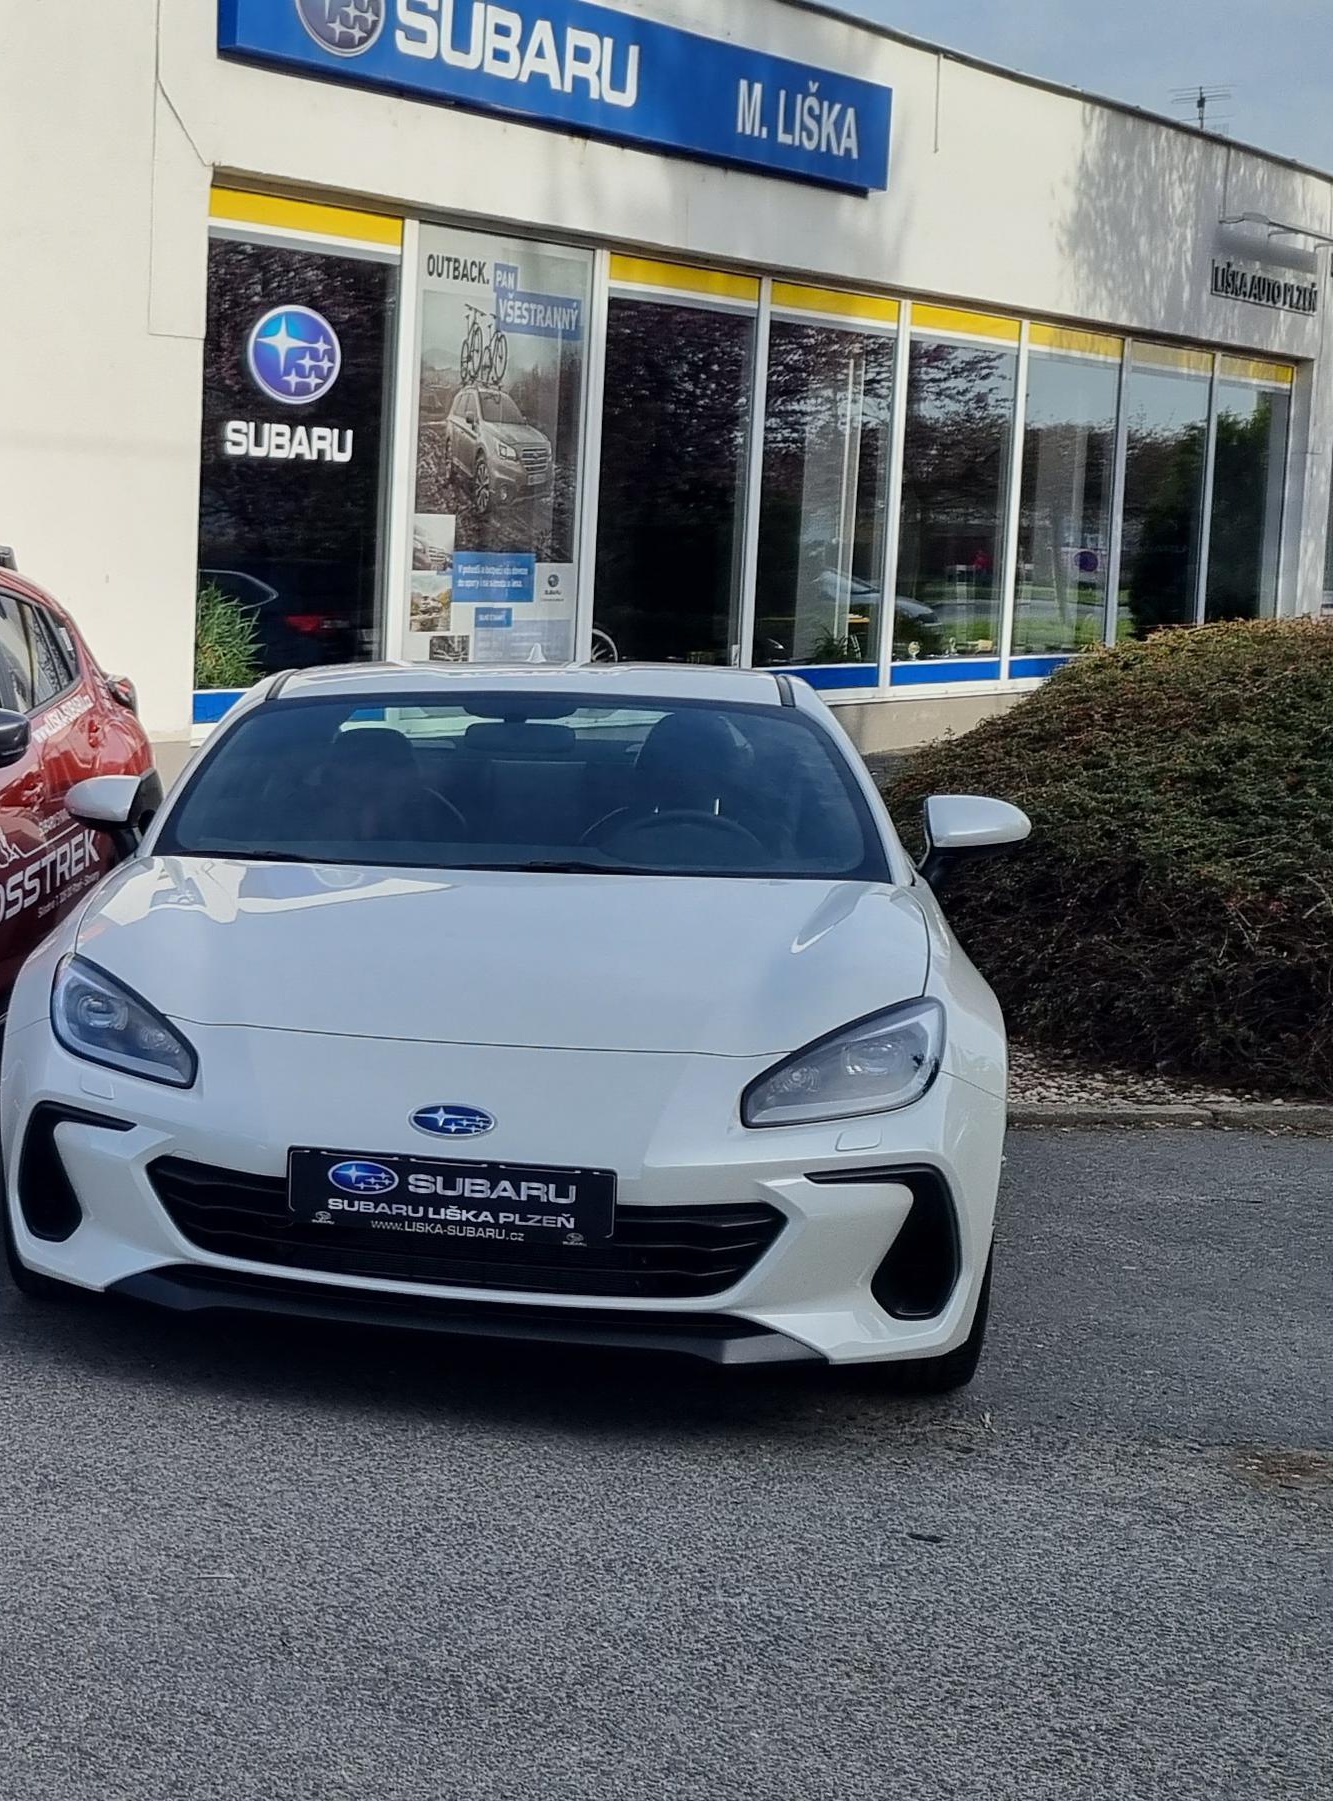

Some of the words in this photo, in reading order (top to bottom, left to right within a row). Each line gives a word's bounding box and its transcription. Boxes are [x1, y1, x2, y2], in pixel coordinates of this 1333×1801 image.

[395, 0, 640, 108] SUBARU
[737, 79, 767, 139] M.
[777, 80, 860, 160] LIŠKA
[427, 253, 490, 285] OUTBACK.
[495, 269, 515, 290] PAN
[1214, 261, 1247, 298] LIŠKA
[1247, 274, 1282, 305] AUTO
[499, 291, 579, 331] VŠESTRANNÝ
[224, 420, 353, 463] SUBARU
[407, 1172, 577, 1204] SUBARU
[327, 1197, 423, 1219] SUBARU
[428, 1205, 494, 1225] LIŠKA
[499, 1213, 576, 1230] PLZEŇ
[371, 1219, 525, 1243] www.LISKA-SUBARU.cz
